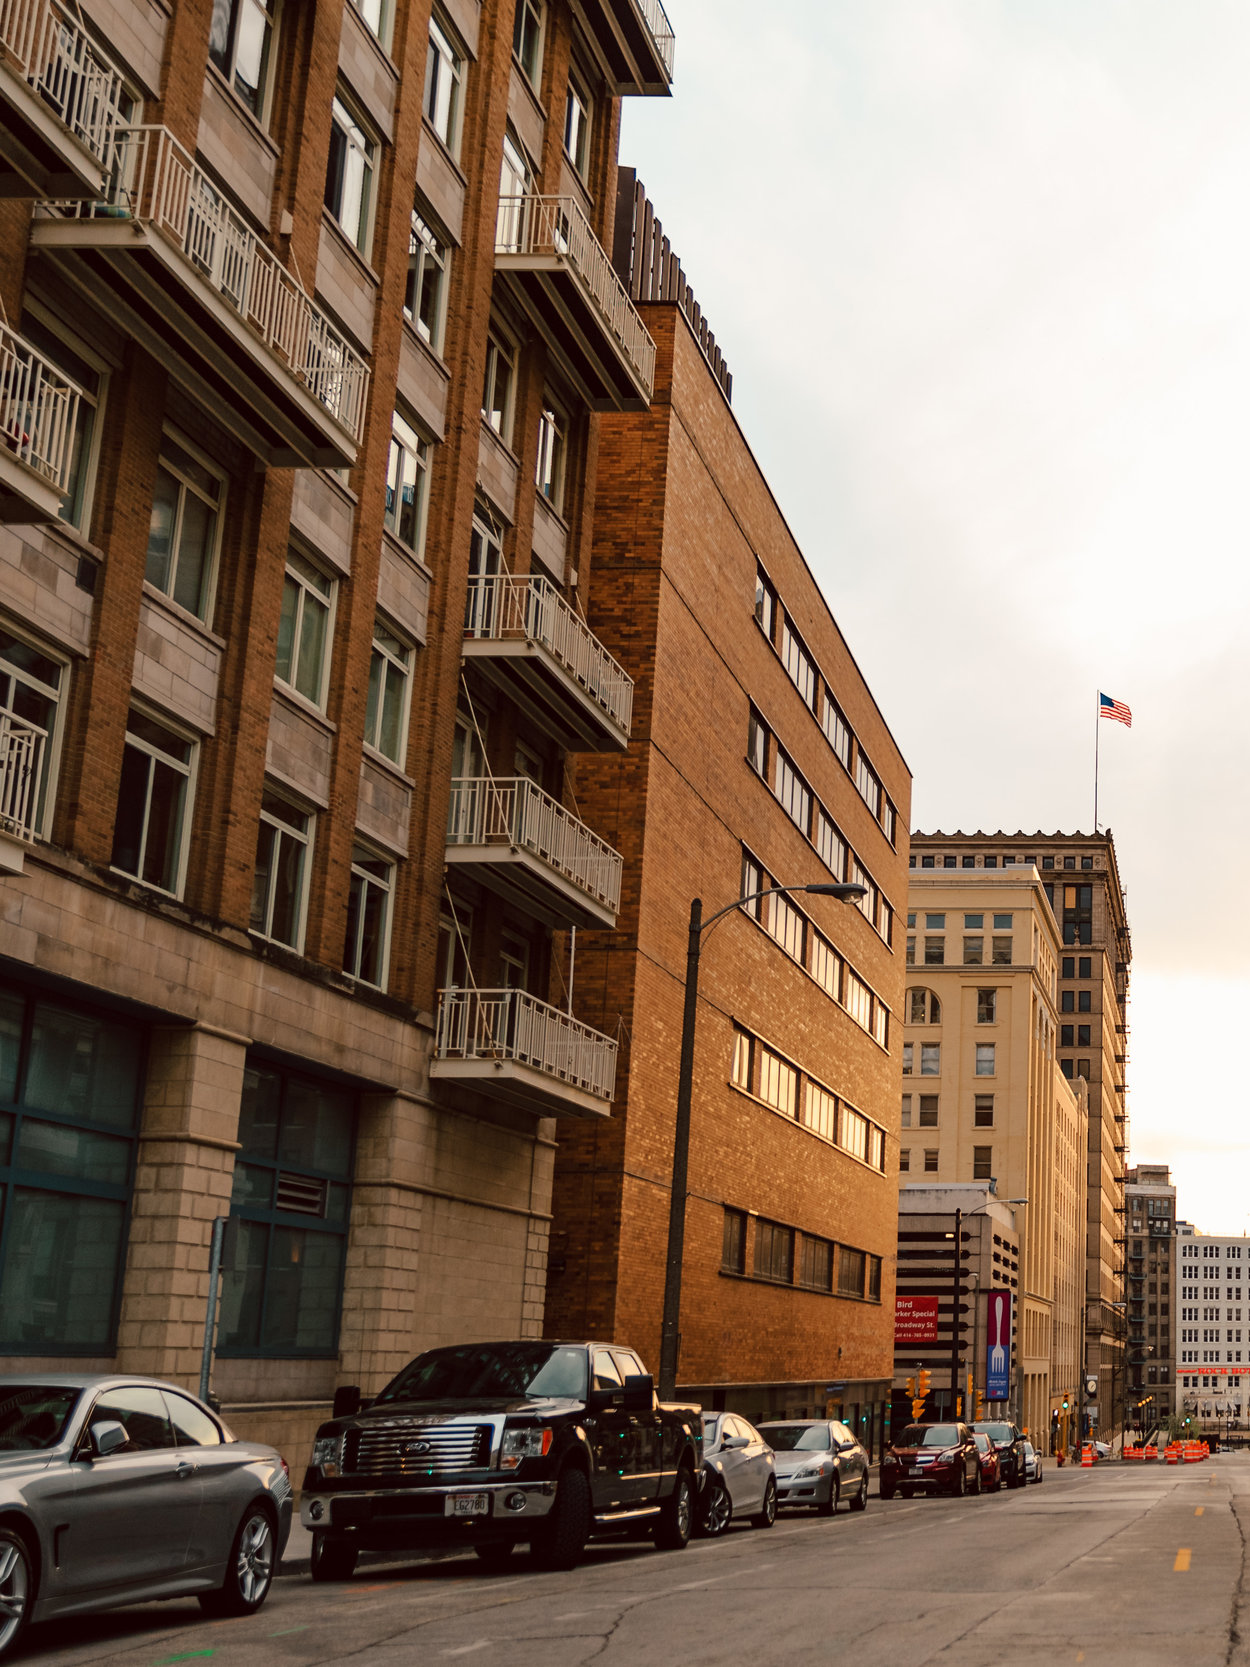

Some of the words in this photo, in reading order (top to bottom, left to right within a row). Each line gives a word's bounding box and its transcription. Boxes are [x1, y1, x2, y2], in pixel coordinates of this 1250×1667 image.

[896, 1301, 913, 1309] Bird
[912, 1310, 936, 1319] Special
[1197, 1367, 1229, 1375] ROCK
